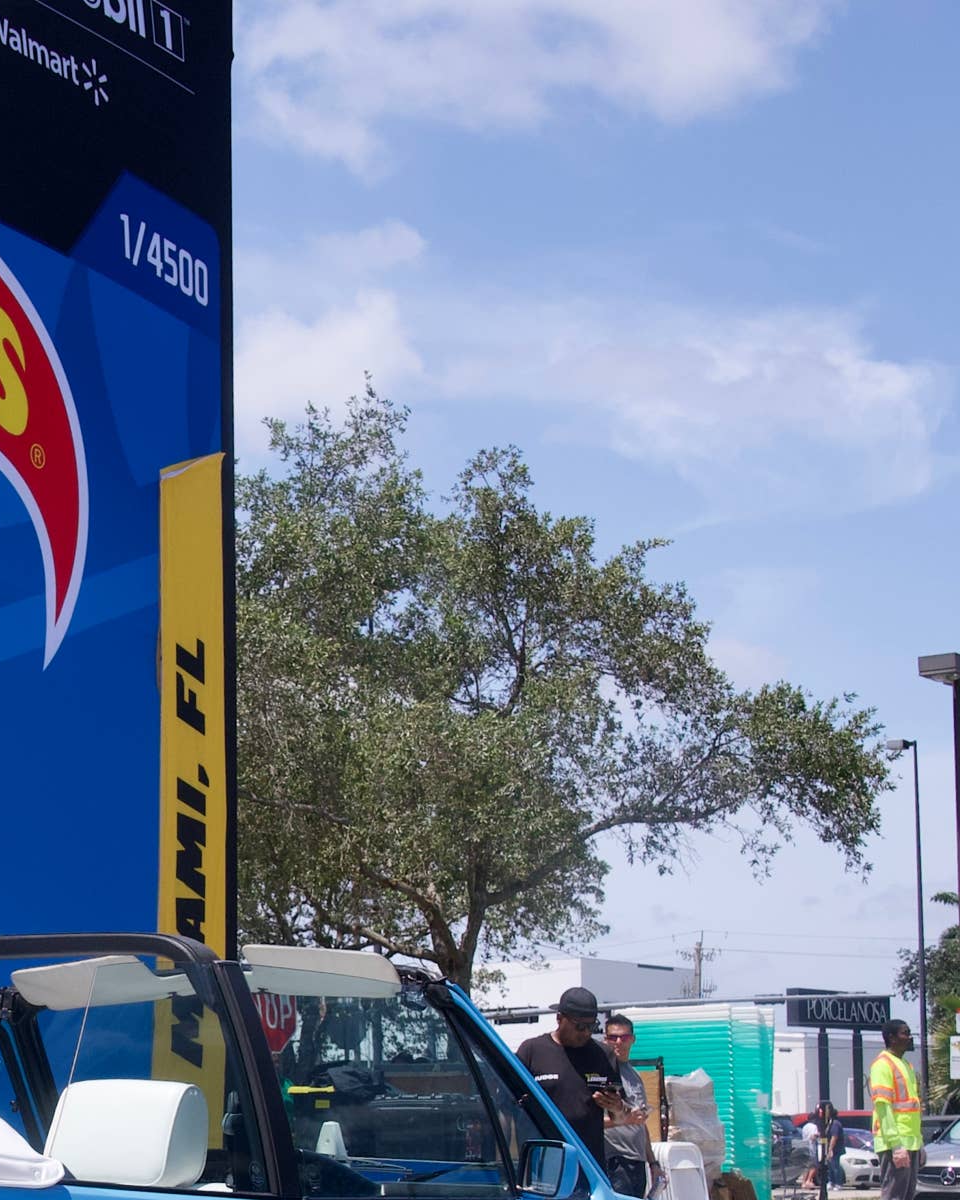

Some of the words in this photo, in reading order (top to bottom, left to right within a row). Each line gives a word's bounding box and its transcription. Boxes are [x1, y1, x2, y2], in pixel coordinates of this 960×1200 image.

[159, 9, 173, 51] 1
[119, 213, 209, 307] 1/4500
[176, 638, 206, 735] FL
[171, 765, 211, 1068] MAMI,
[807, 998, 887, 1023] PORCELANOSA
